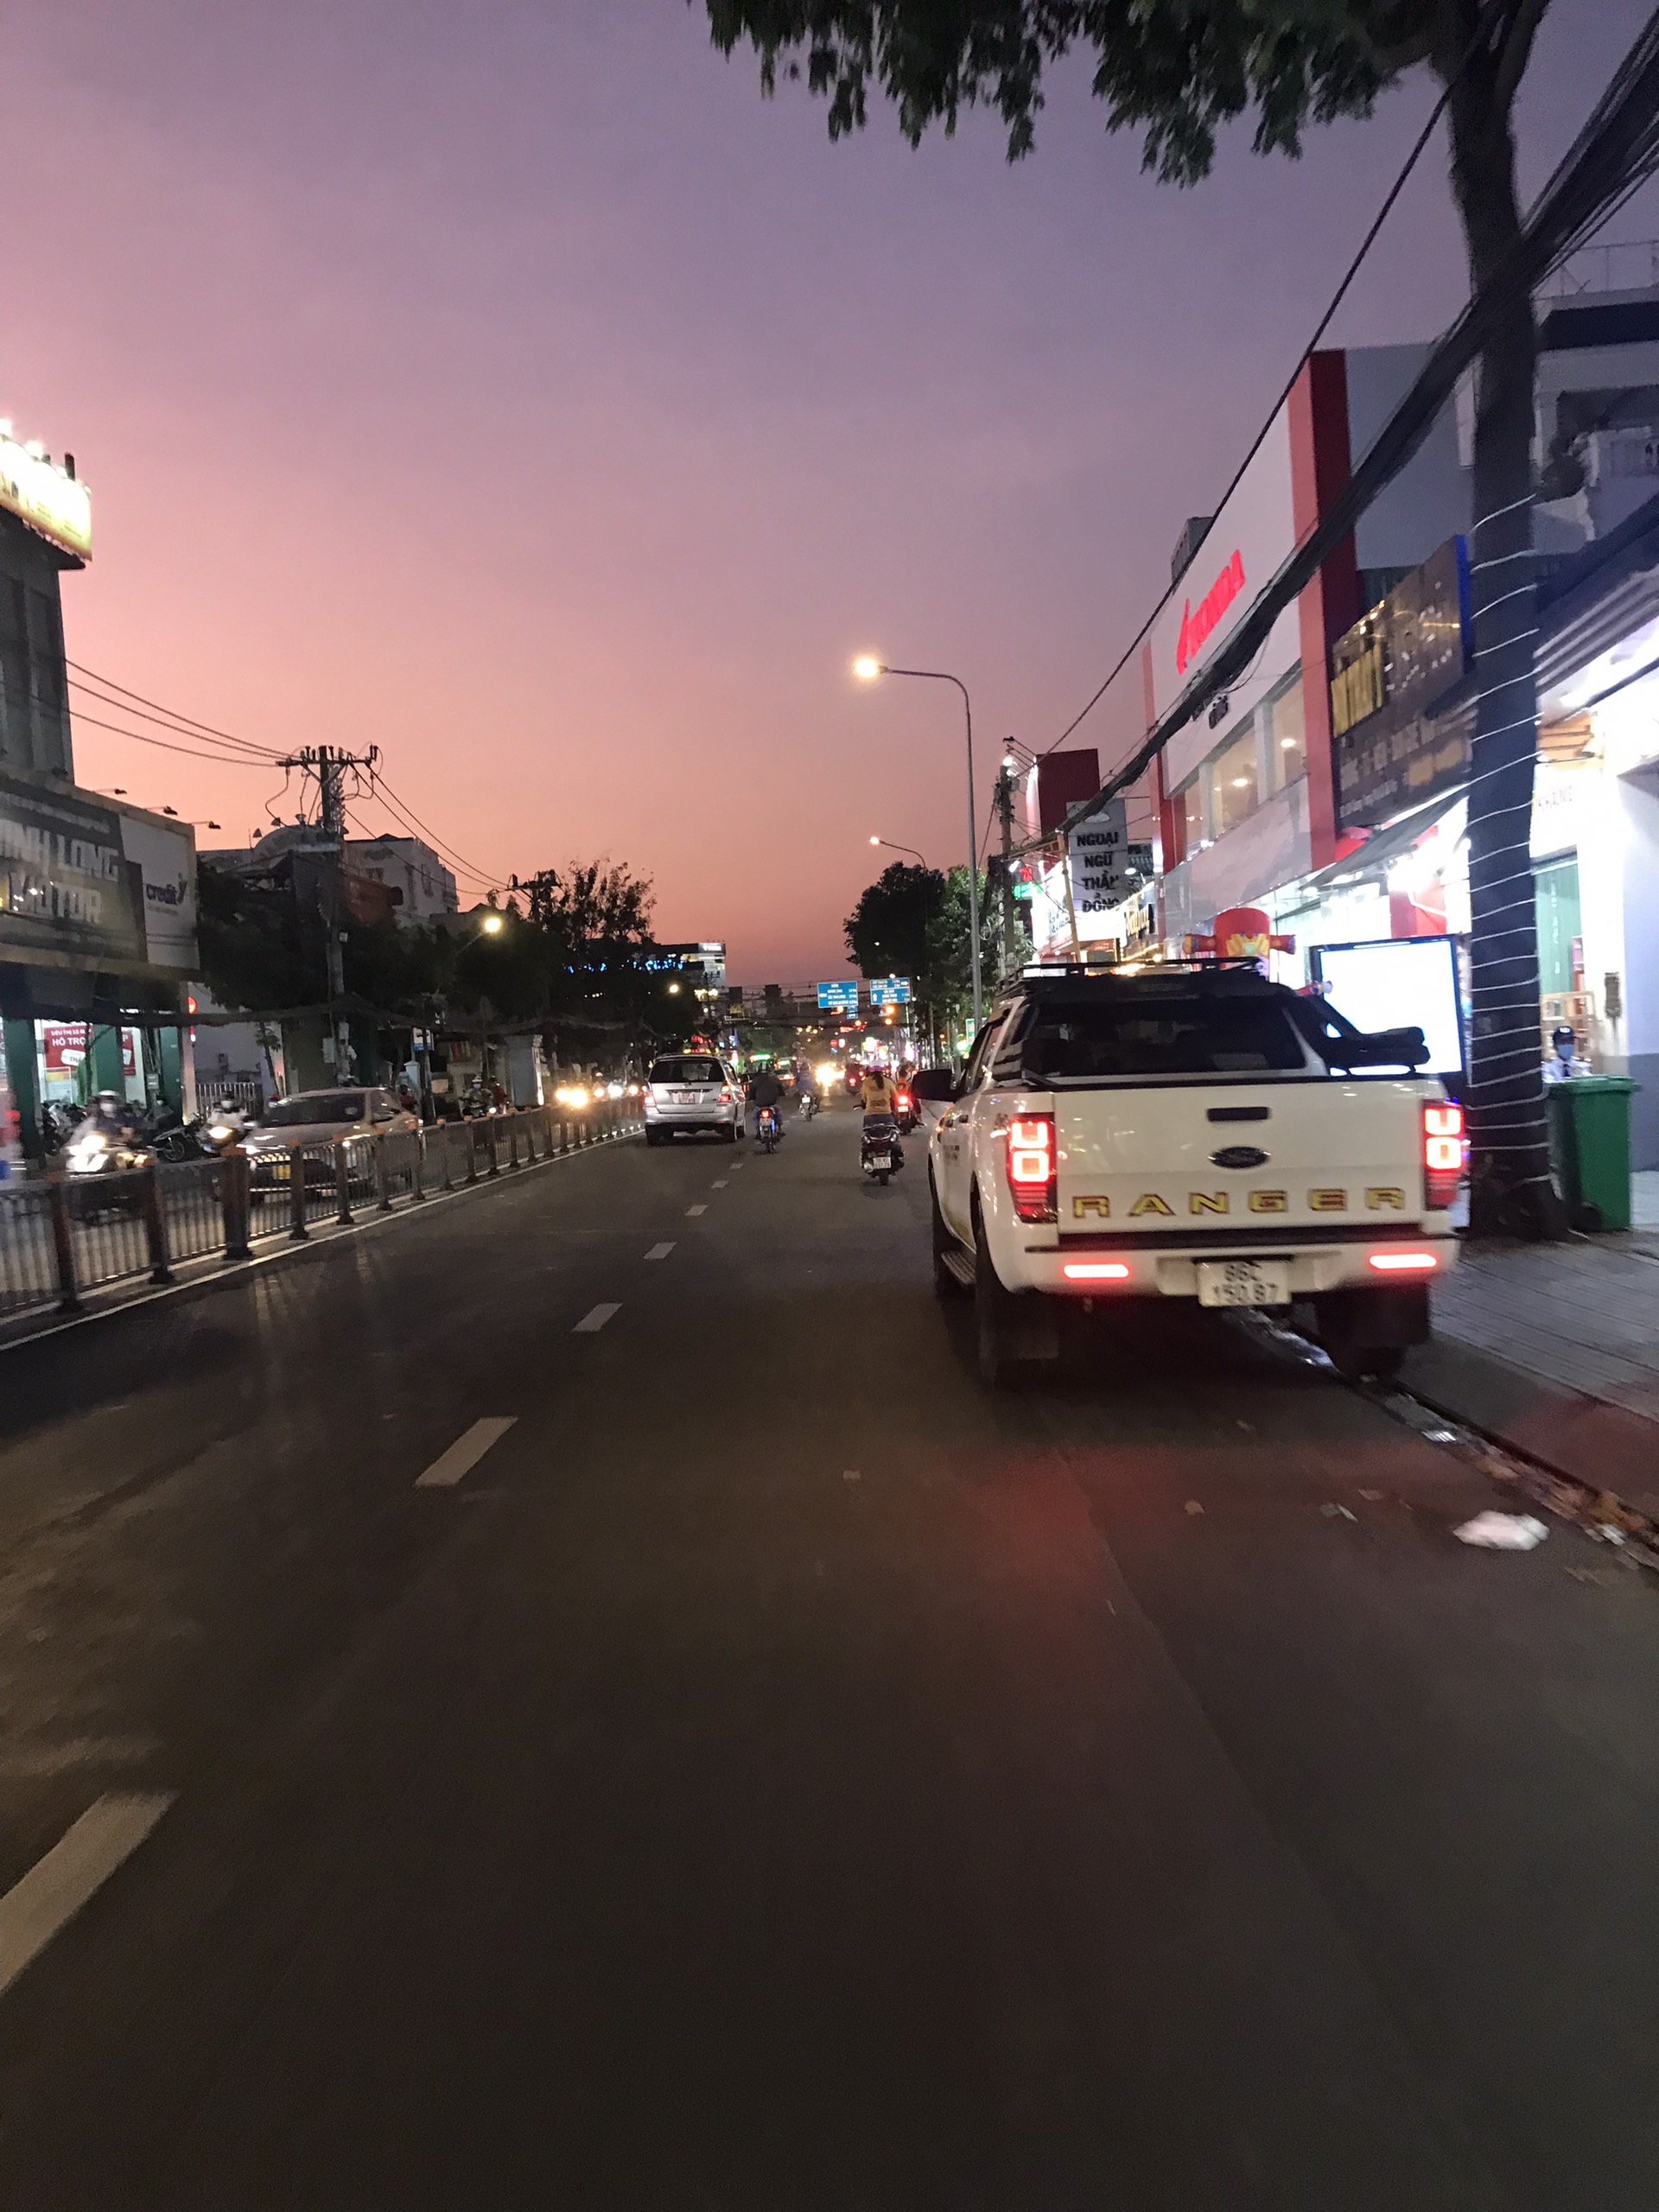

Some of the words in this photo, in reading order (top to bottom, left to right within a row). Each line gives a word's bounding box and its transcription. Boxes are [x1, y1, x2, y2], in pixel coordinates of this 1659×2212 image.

[1076, 831, 1119, 848] NGOẠI
[57, 834, 119, 881] LONG
[1072, 1187, 1407, 1218] RANGER
